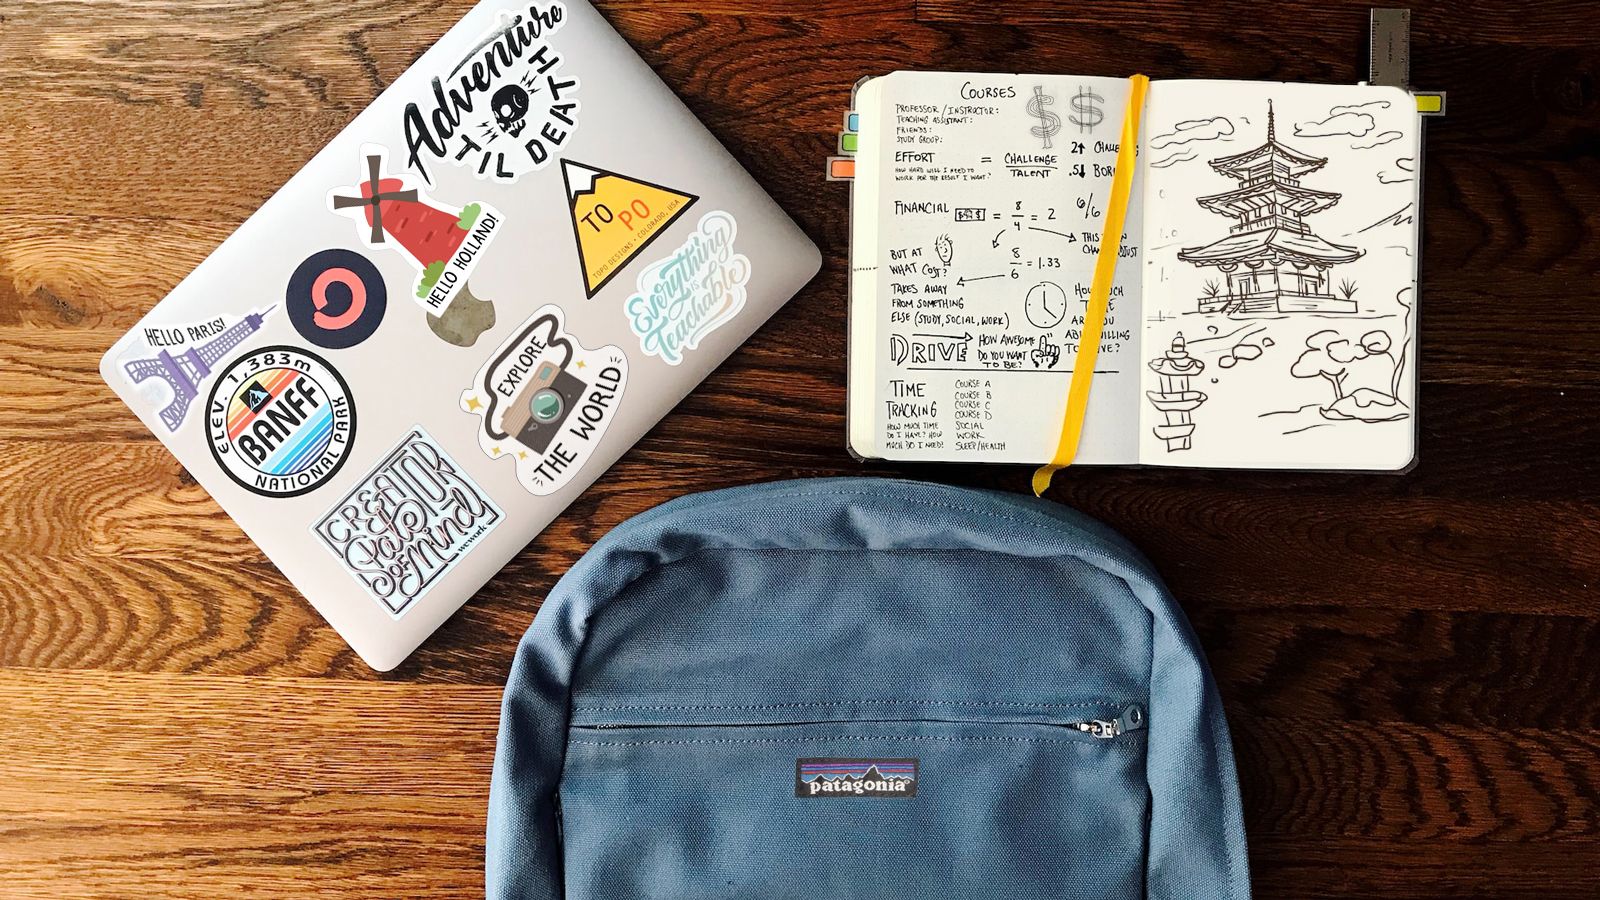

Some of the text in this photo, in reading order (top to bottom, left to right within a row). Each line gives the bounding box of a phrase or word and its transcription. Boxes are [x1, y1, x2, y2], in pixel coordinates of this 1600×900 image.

[403, 5, 562, 185] Adventure
[455, 45, 576, 177] TIL DEATH
[896, 104, 939, 114] PROFESSOR
[896, 115, 929, 124] TEACHING
[895, 151, 935, 163] EFFORT
[1004, 152, 1058, 165] CHALLENGE
[580, 199, 651, 233] TO PO
[895, 200, 950, 215] FINANCIAL
[1048, 208, 1056, 220] 2
[1014, 221, 1021, 231] 4
[592, 264, 609, 279] TOPO
[607, 242, 634, 265] DESIGNS
[667, 199, 681, 212] USA
[1081, 232, 1100, 243] THIS
[426, 212, 500, 309] HELLO HOLLAND!
[890, 248, 923, 261] BUT AT
[1011, 247, 1021, 259] 8
[1038, 256, 1061, 269] 1.33
[628, 214, 733, 334] Everything
[889, 263, 948, 279] WHAT COST?
[1010, 268, 1020, 280] 6
[890, 283, 948, 295] TAKES AWAY
[644, 257, 747, 361] Teachable
[891, 297, 964, 310] FROM SOMETHING
[891, 311, 911, 323] ELSE
[1071, 315, 1085, 326] AR
[144, 317, 227, 348] HELLO PARIS!
[890, 333, 1035, 367] DRIVE HOW AWESOME
[977, 349, 1028, 361] DO YOU WANT
[227, 352, 312, 385] 1,383m
[497, 335, 547, 398] EXPLORE
[982, 361, 1023, 369] TO BE?
[889, 379, 927, 398] TIME
[954, 379, 992, 389] COURSE A
[954, 390, 992, 400] COURSE B
[885, 400, 937, 420] TRACKING
[954, 400, 991, 410] COURSE C
[238, 376, 320, 466] BANFF
[954, 410, 993, 420] COURSE D
[533, 366, 622, 482] THE WORLD
[955, 420, 985, 430] SOCIAL
[254, 395, 349, 492] NATIONAL PARK
[956, 431, 985, 440] WORK
[325, 440, 457, 544] CREATOR
[399, 487, 487, 598] Mind
[457, 523, 488, 553] wework
[809, 778, 907, 795] patagonia
